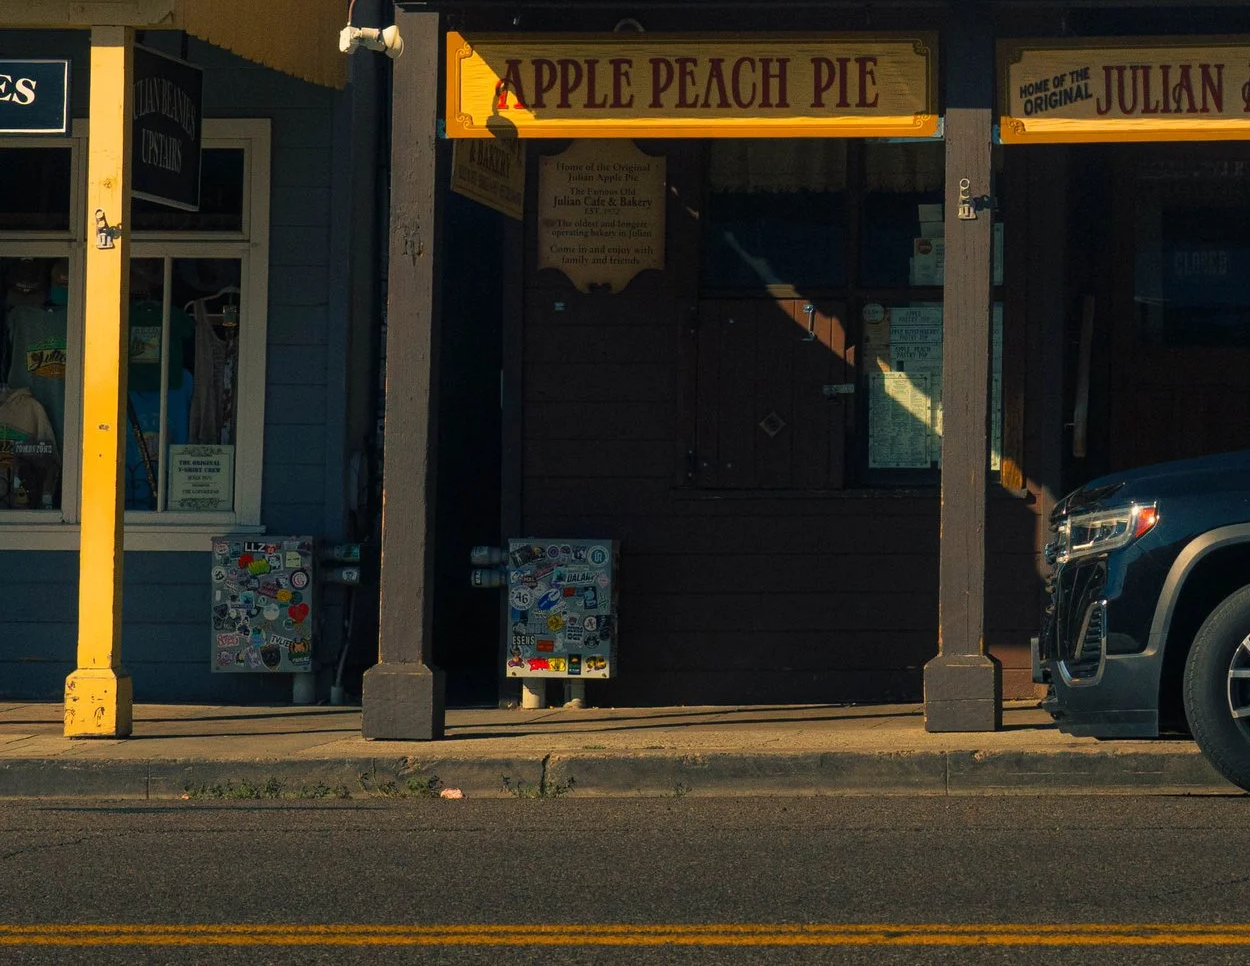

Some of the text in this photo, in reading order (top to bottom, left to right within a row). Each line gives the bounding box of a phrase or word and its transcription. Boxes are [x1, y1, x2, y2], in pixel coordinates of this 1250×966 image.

[496, 55, 880, 110] APPLE PEACH PIE
[1019, 67, 1091, 100] HOME OF THE
[1096, 63, 1226, 116] JULIAN
[1023, 85, 1093, 117] ORIGINAL
[141, 127, 182, 173] UPSTAIRS
[556, 163, 583, 171] Home
[613, 163, 651, 174] Original
[552, 196, 653, 210] Julian Cafe & Bakery
